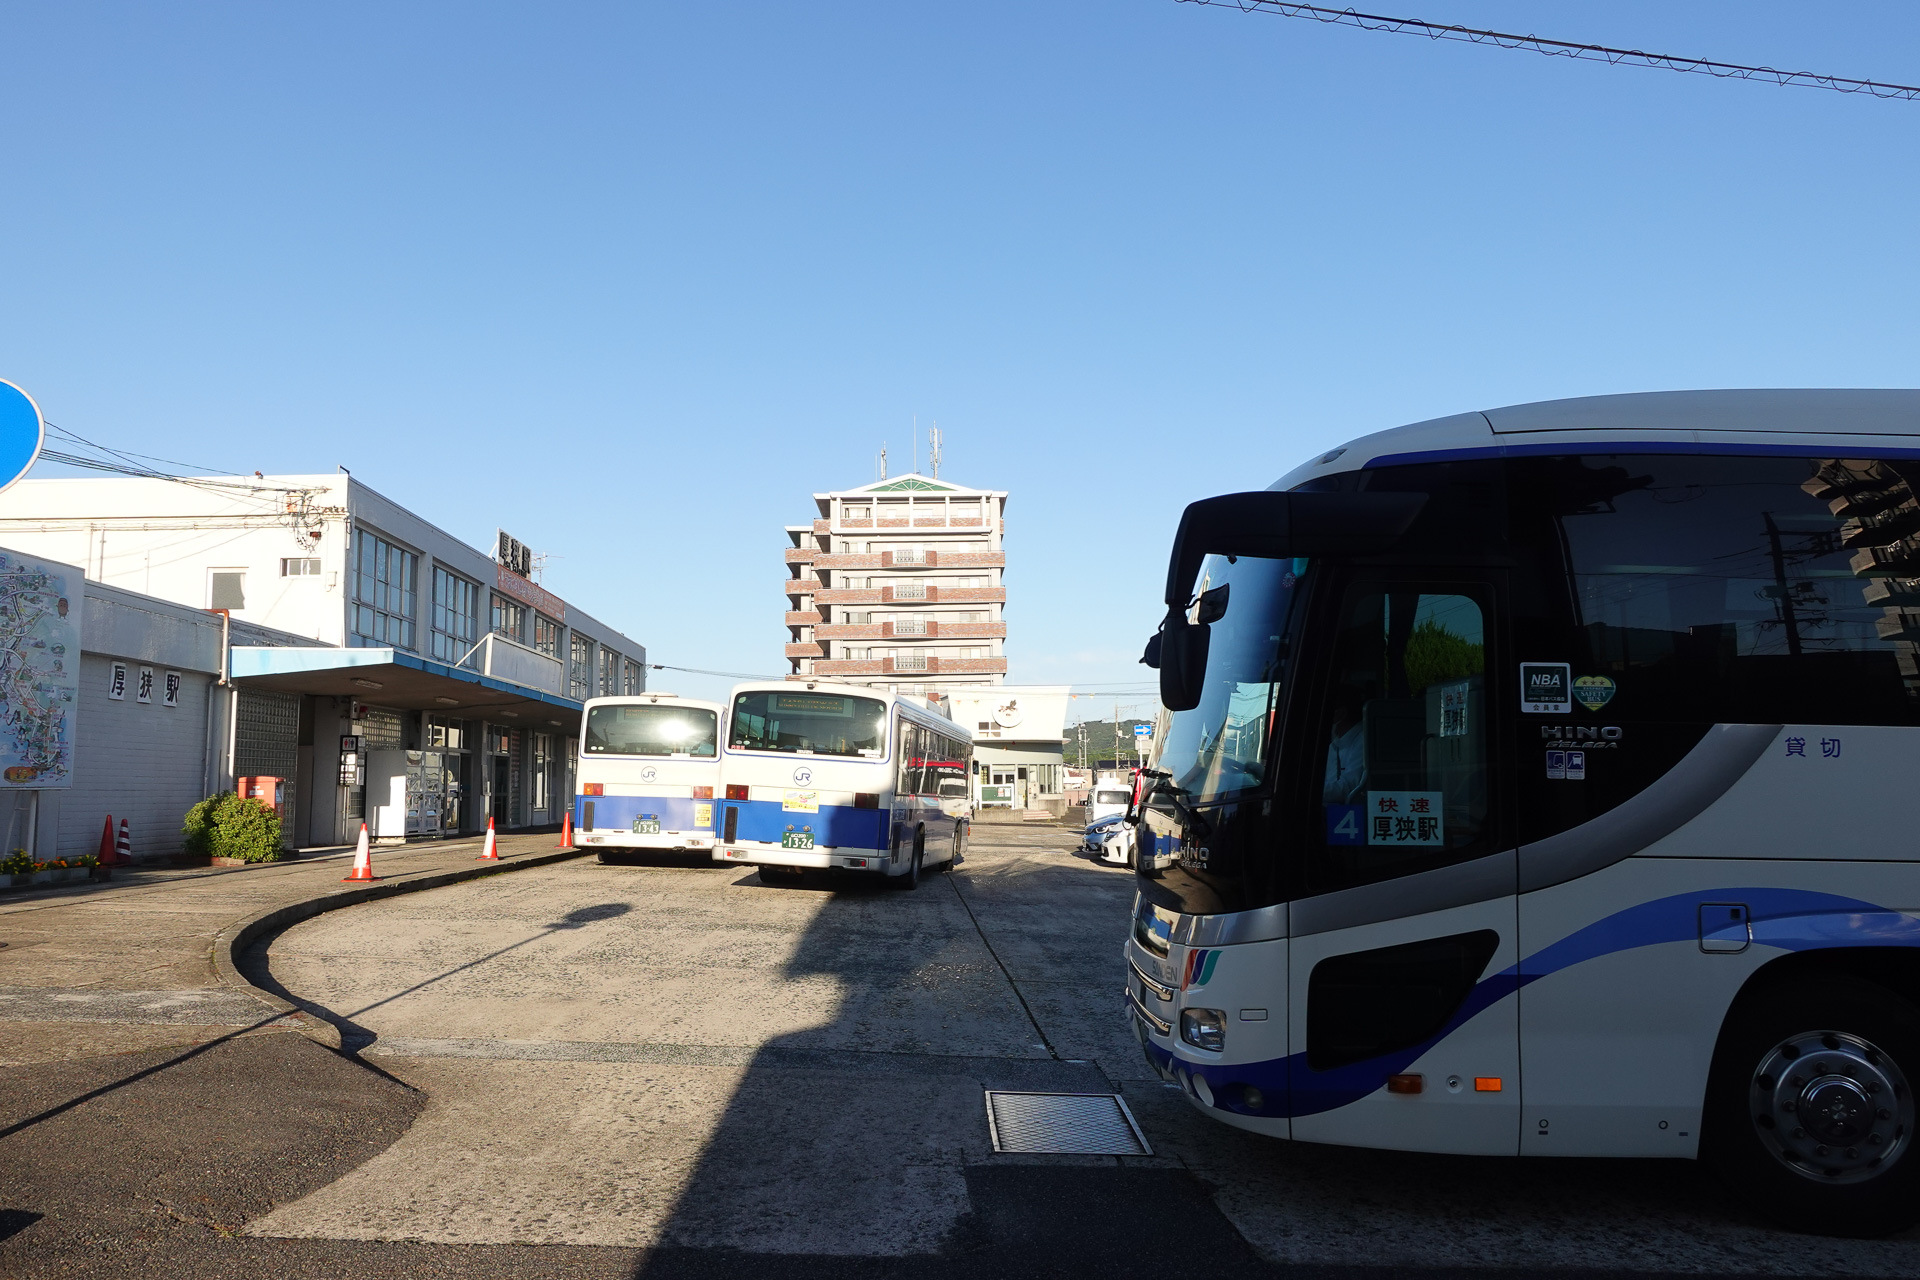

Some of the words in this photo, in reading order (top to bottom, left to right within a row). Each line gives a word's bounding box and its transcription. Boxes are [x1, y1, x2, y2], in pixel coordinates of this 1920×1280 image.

[111, 665, 180, 703] 厚狭駅
[1531, 674, 1561, 685] NBA
[1541, 725, 1623, 741] HINO
[1785, 736, 1841, 758] 貸切
[1379, 797, 1430, 813] 快速
[638, 824, 659, 833] 13-43
[1333, 809, 1359, 839] 4
[1372, 816, 1439, 841] 厚狭駅
[788, 837, 813, 849] 13-26
[1180, 846, 1210, 861] HINO
